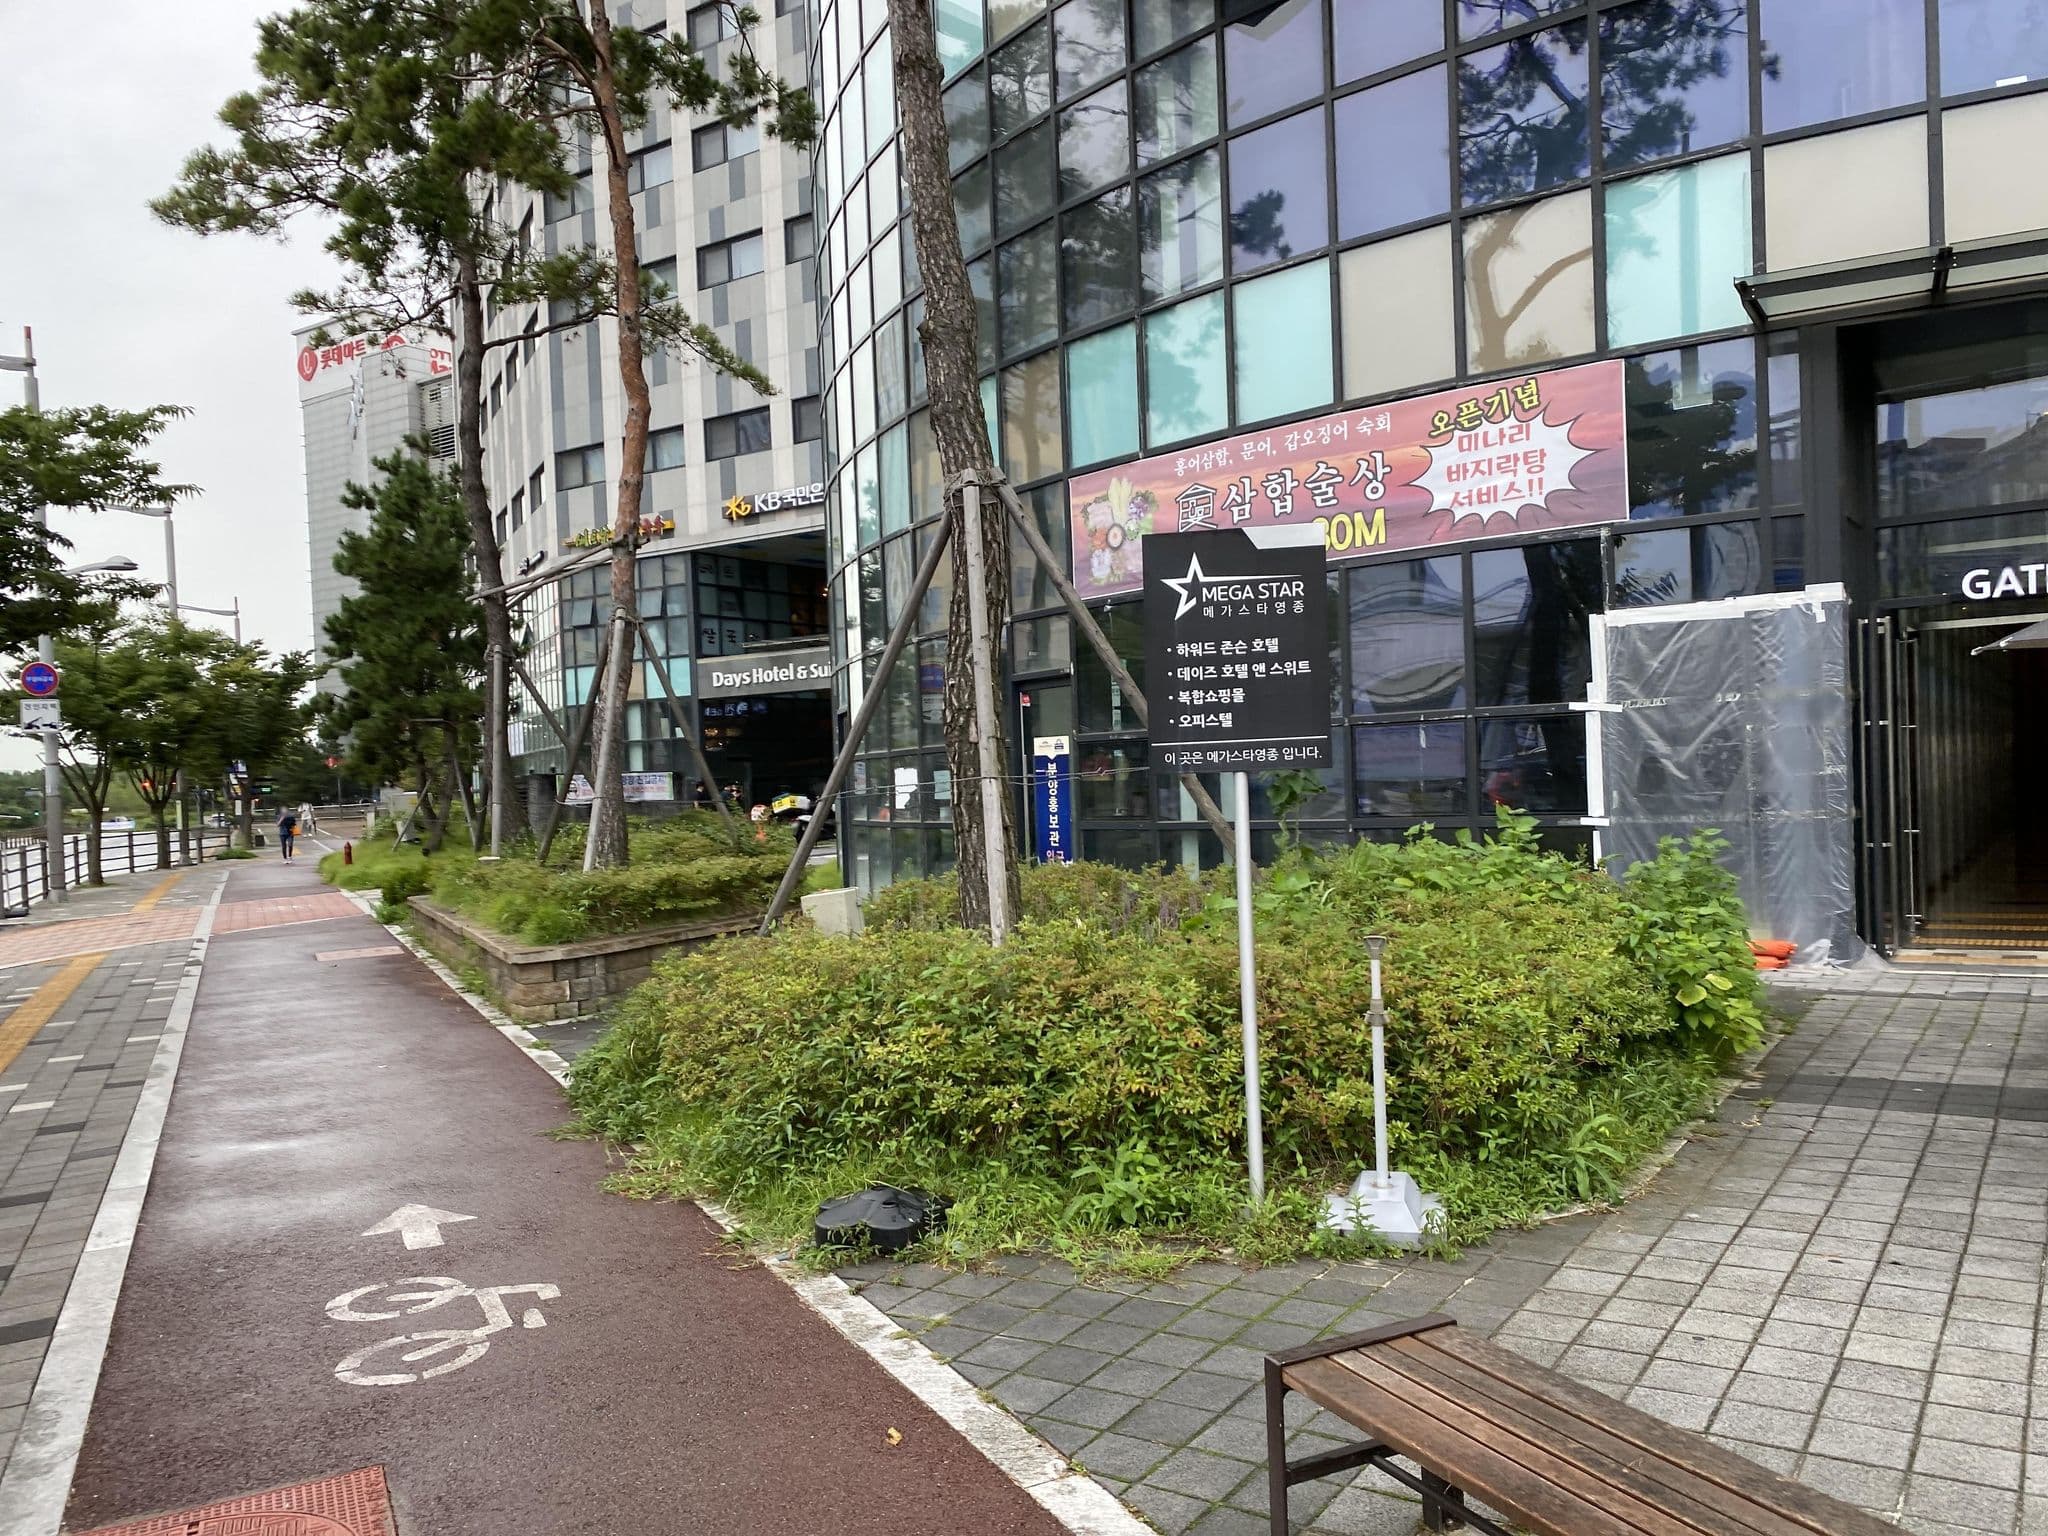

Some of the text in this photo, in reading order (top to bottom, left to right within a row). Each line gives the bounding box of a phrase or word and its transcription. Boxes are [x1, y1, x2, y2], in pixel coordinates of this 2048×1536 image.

[320, 339, 367, 369] 롯데마트
[1428, 377, 1541, 438] 오픈기념
[1174, 412, 1392, 477] 홍어삼합, 문어, 갑오징어 숙회
[1457, 422, 1532, 452] 미나리
[1446, 448, 1547, 482] 바지락탕
[1220, 450, 1392, 525] 삼합술상
[1449, 477, 1544, 508] 서비스!!
[1202, 581, 1305, 602] MEGA STAR
[1962, 563, 2048, 600] GAT
[1176, 637, 1279, 657] 하워드 존슨 호텔
[712, 671, 751, 688] Days
[752, 663, 794, 683] Hotel
[797, 665, 808, 680] &
[1177, 660, 1311, 681] 데이즈 호텔 앤 스위트
[1178, 687, 1246, 705] 복합쇼핑몰
[1179, 712, 1233, 728] 오피스텔
[1165, 745, 1323, 765] 이 곳은 메가스타영종 입니다.
[1047, 762, 1060, 847] 분양홍보관
